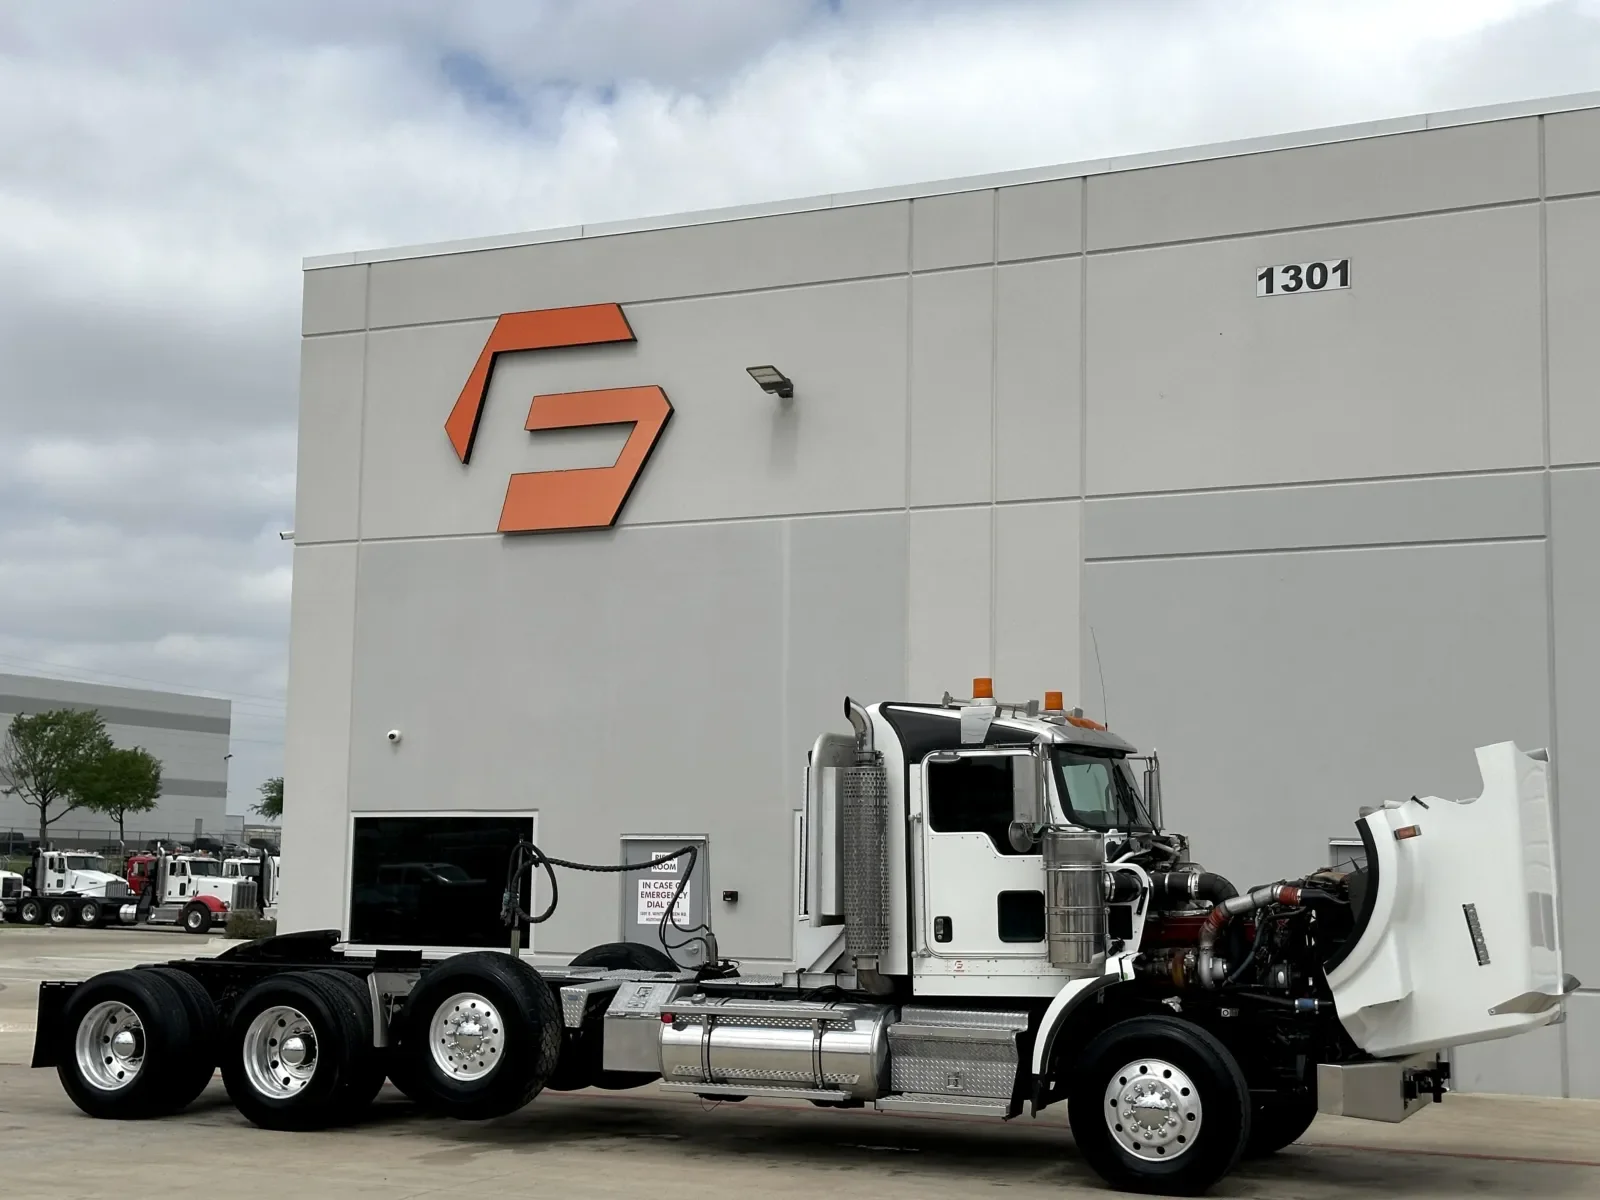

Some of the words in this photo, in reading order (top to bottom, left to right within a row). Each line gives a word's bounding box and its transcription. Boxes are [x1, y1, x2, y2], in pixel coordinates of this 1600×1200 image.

[1258, 260, 1348, 294] 1301
[653, 881, 673, 890] CASE
[1463, 903, 1491, 965] KENWORTH
